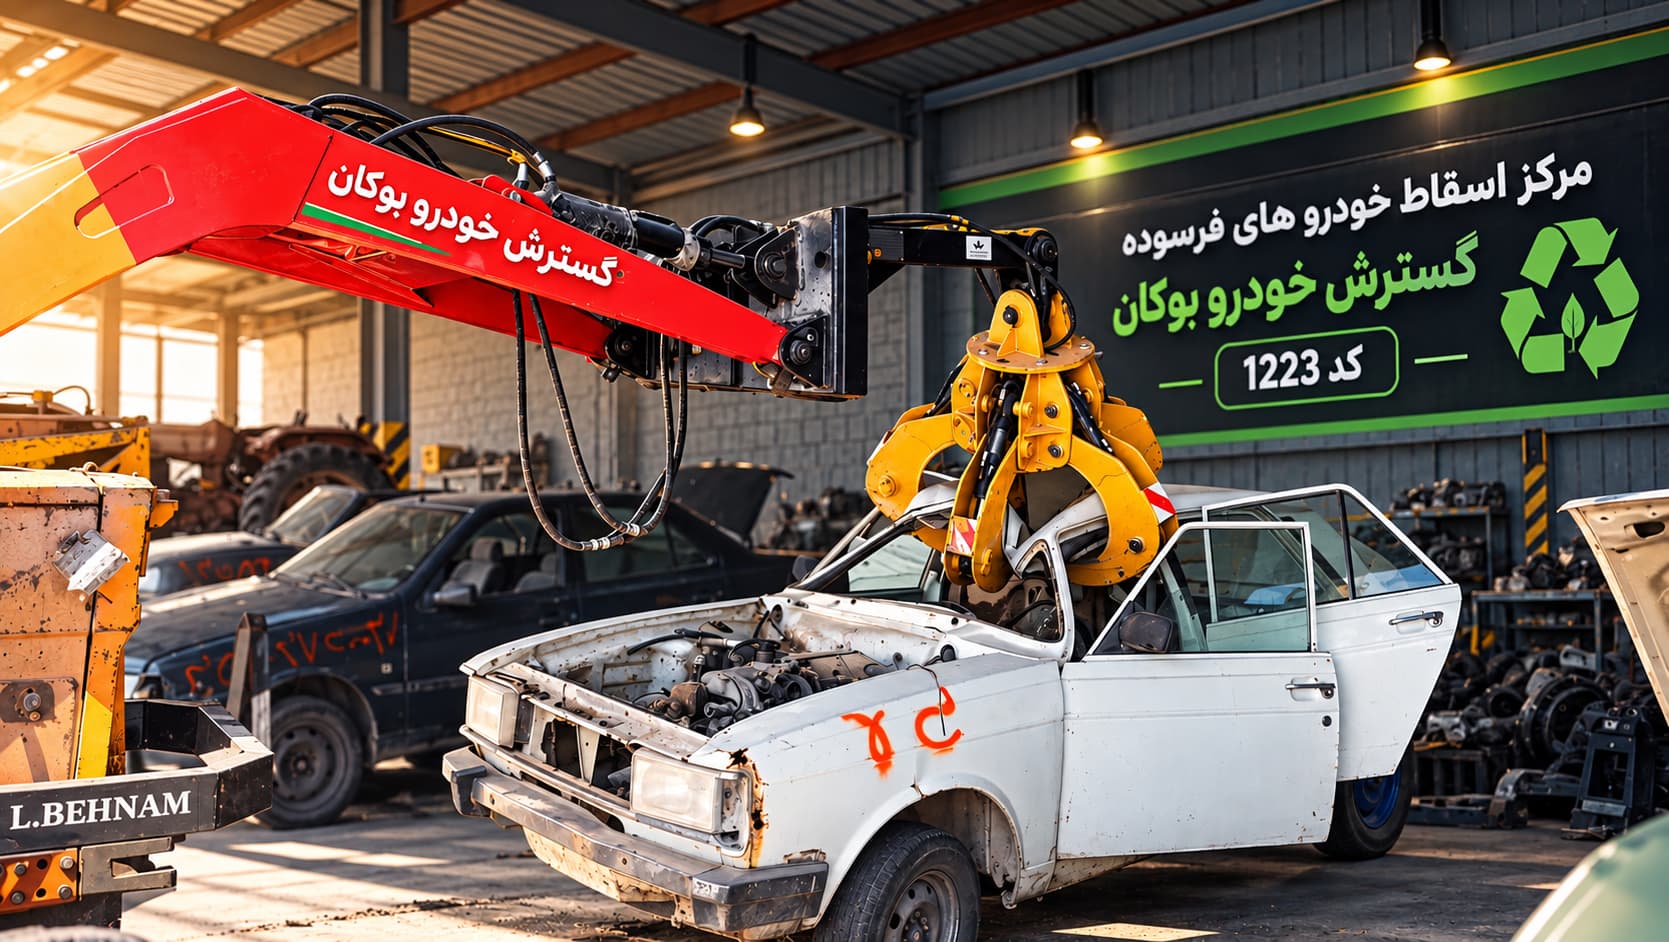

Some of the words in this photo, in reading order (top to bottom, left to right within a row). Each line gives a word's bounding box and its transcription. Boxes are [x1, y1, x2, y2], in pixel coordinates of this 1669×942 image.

[327, 163, 408, 219] بوکان
[1399, 161, 1507, 213] اسقاط
[1516, 152, 1593, 206] مرکز
[409, 197, 500, 245] خودرو
[1121, 208, 1226, 260] فرسوده
[1232, 201, 1296, 246] های
[1303, 183, 1392, 238] خودرو
[502, 228, 618, 287] گسترش
[1325, 230, 1480, 314] گسترش
[1112, 276, 1200, 337] بوکان
[1207, 260, 1317, 328] خودرو
[1242, 348, 1321, 391] 1223
[1328, 343, 1364, 382] کد
[9, 790, 192, 831] L.BEHNAM
